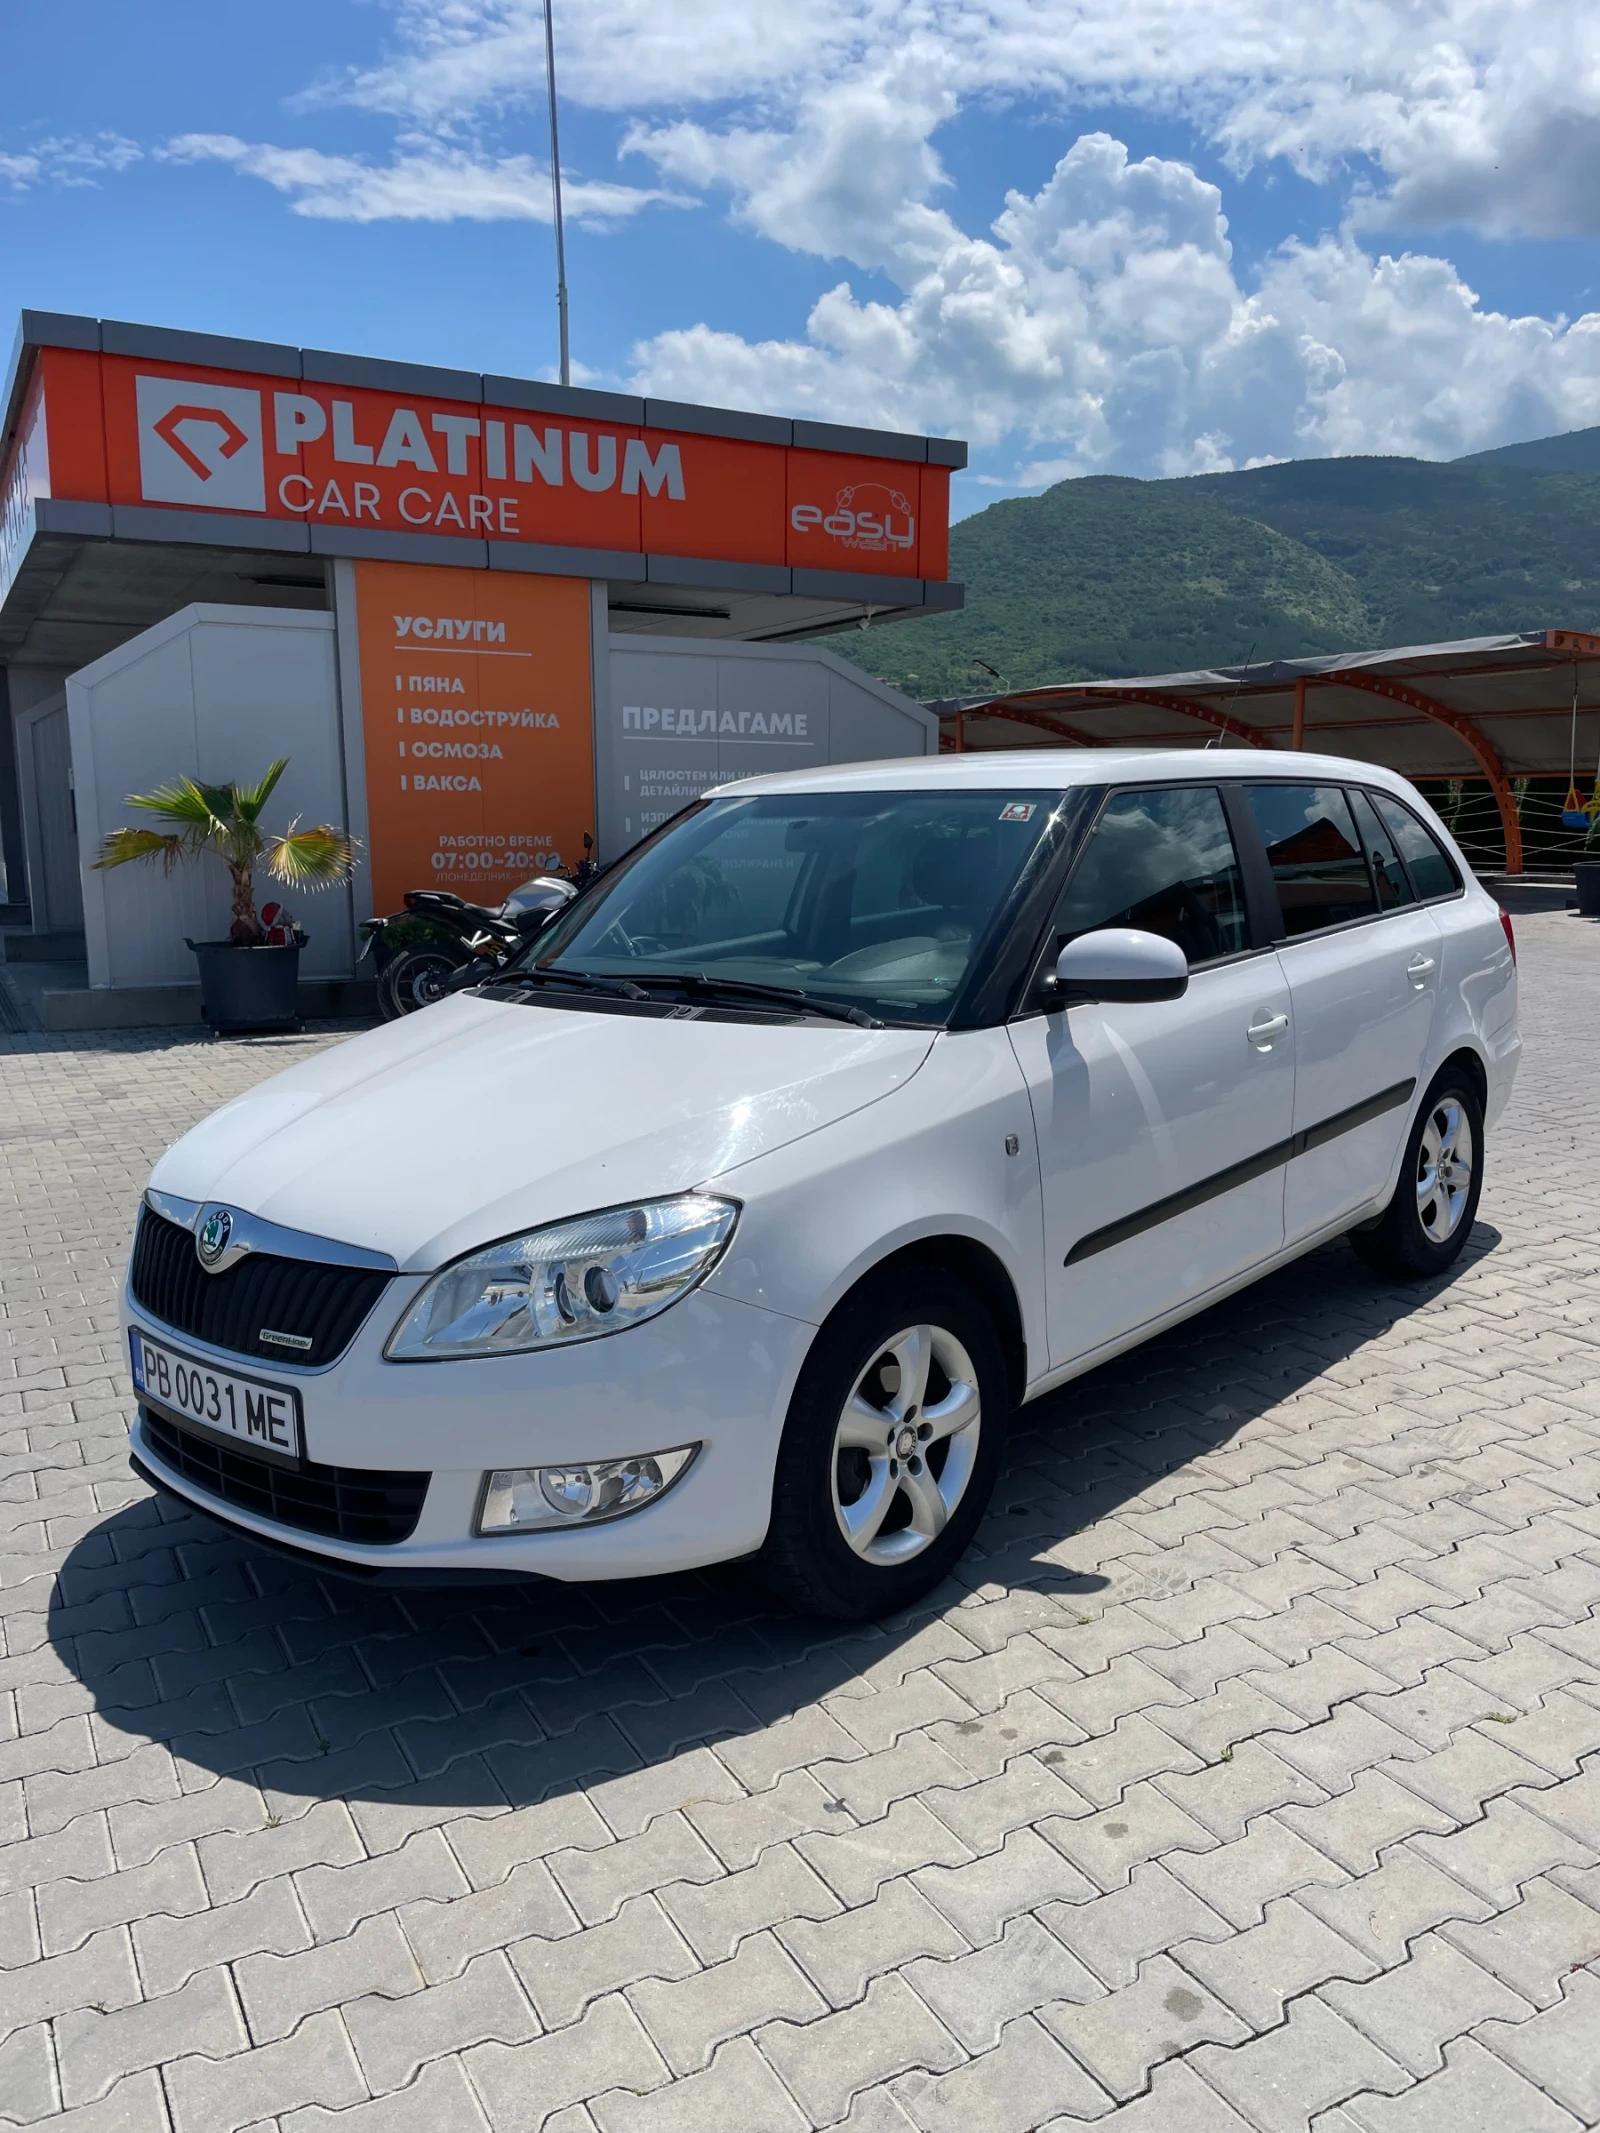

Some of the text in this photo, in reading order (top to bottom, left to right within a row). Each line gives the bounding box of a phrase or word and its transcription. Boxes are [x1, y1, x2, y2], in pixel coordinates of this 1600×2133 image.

[273, 391, 686, 501] PLATINUM
[279, 474, 519, 533] CAR CARE
[791, 504, 915, 548] easy
[841, 536, 897, 552] wash
[393, 615, 506, 642] УСЛУГИ
[408, 675, 465, 693] ПЯНА
[410, 707, 560, 728] ВОДОСТРУЙКА
[622, 706, 807, 735] ПРЕДЛАГАМЕ
[411, 741, 503, 759] ОСМОЗА
[413, 775, 482, 791] ВАКСА
[639, 769, 706, 782] ЦЯЛОСТЕН
[709, 771, 734, 783] ИЛИ
[439, 835, 552, 847] РАБОТНО ВРЕМЕ
[175, 1363, 237, 1430] 0031
[245, 1389, 290, 1448] ME
